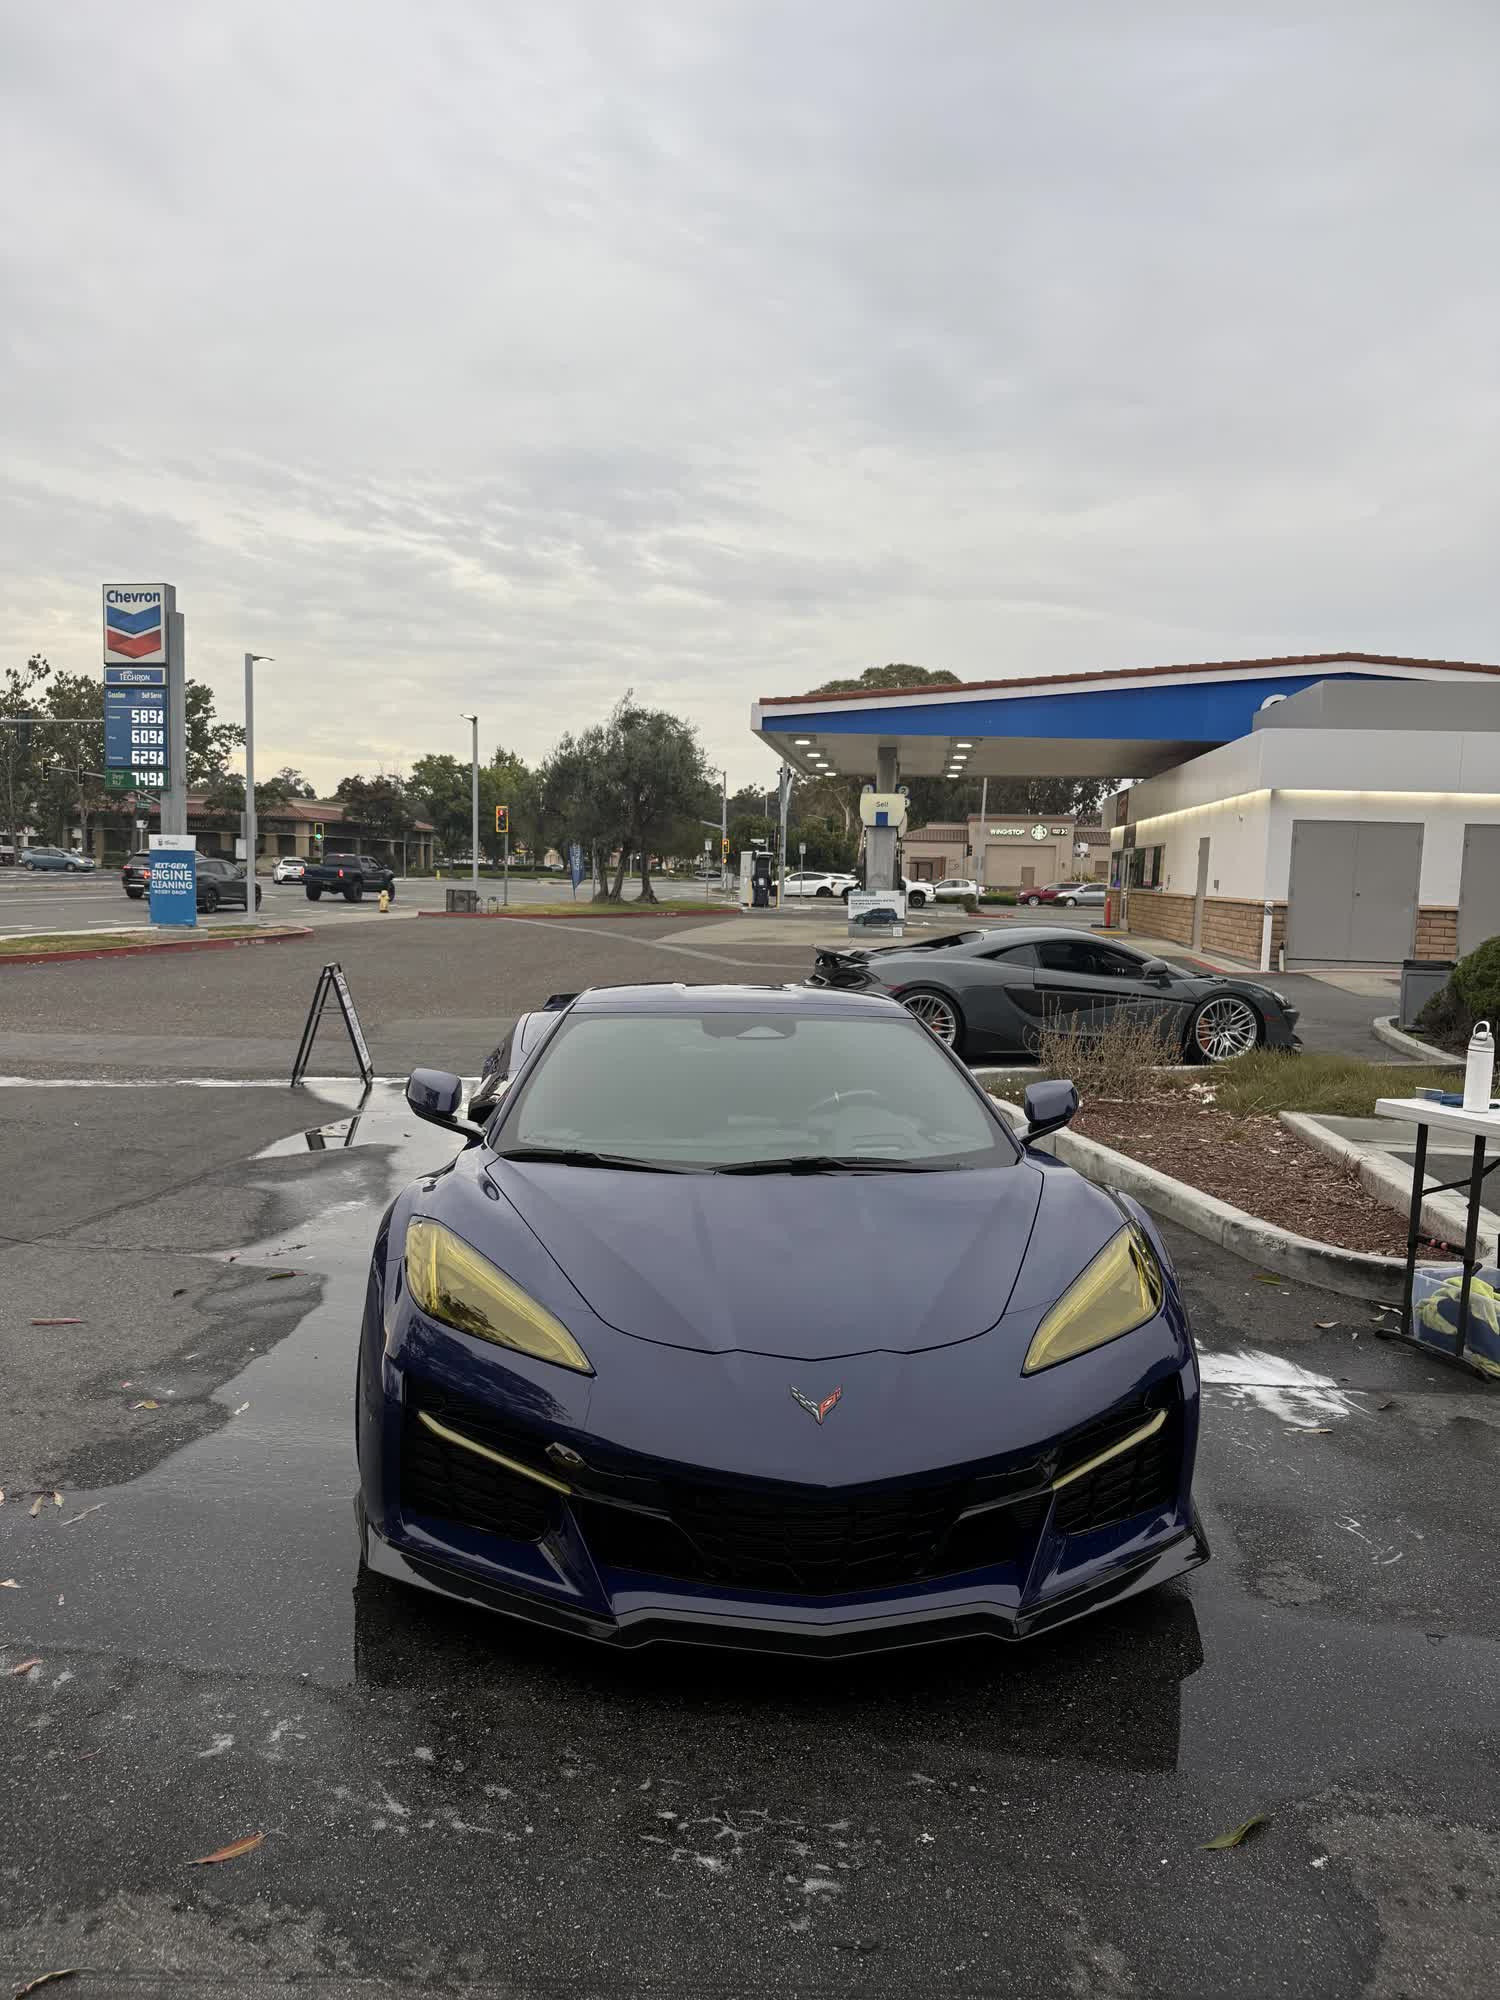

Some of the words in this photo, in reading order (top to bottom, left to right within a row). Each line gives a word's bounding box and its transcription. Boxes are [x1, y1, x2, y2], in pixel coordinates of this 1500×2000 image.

[106, 590, 161, 603] Chevron
[119, 673, 151, 682] TECHRON
[151, 869, 193, 881] ENGINE
[151, 880, 193, 890] CLEANING
